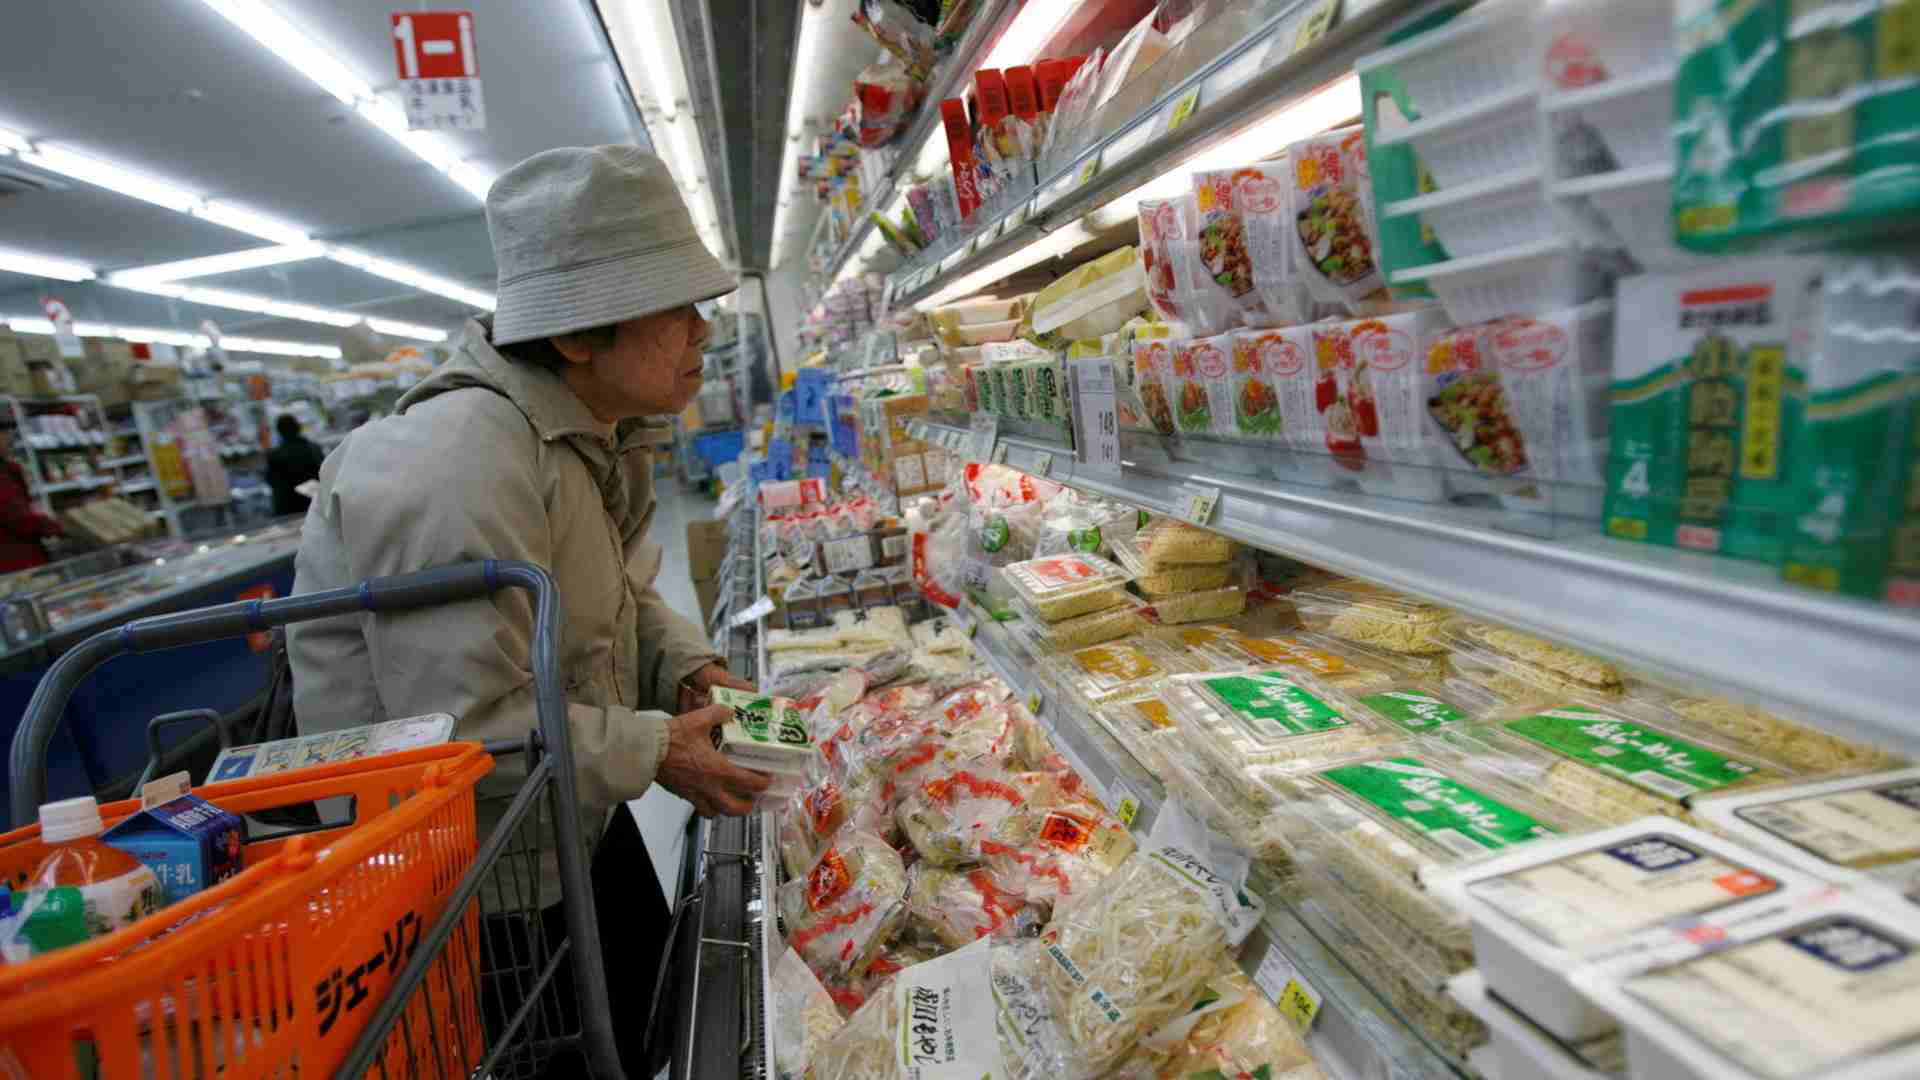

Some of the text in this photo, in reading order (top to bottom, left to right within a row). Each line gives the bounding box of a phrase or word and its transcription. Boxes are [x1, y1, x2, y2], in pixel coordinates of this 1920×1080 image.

[315, 910, 422, 1038] ジェーソン
